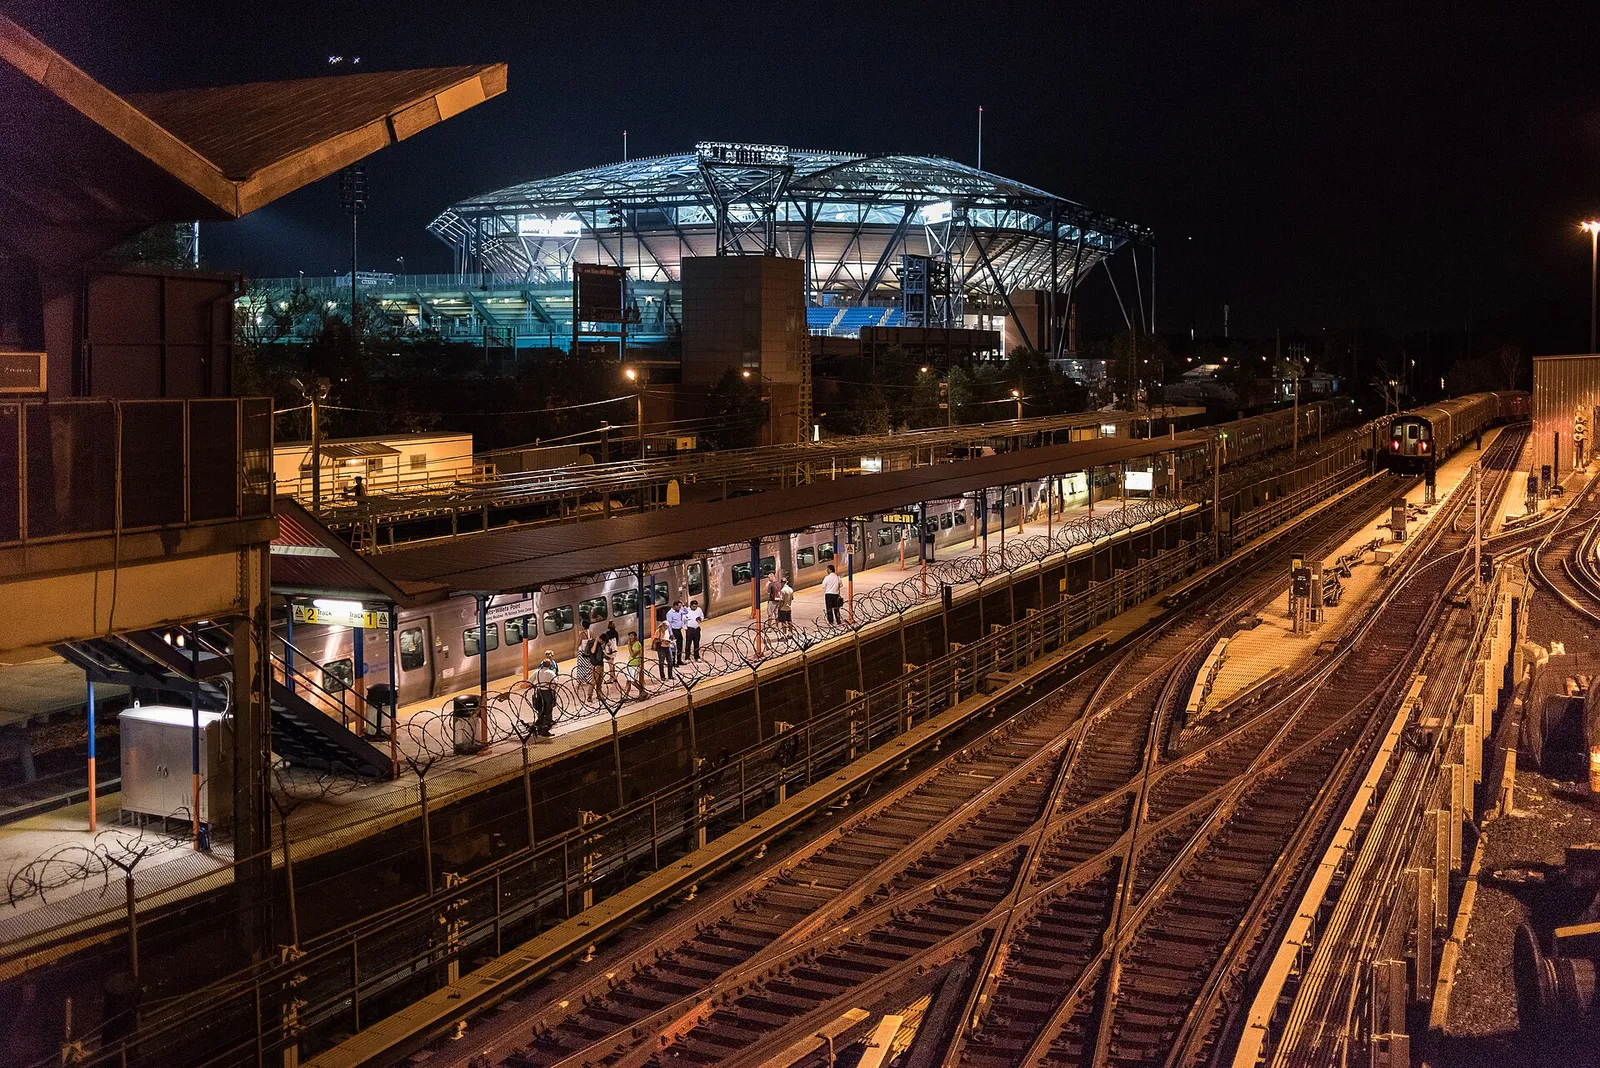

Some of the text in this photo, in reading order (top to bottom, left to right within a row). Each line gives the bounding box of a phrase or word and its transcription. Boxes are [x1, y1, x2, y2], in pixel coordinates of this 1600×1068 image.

[307, 608, 332, 621] 2 Track
[349, 611, 372, 625] Track 1
